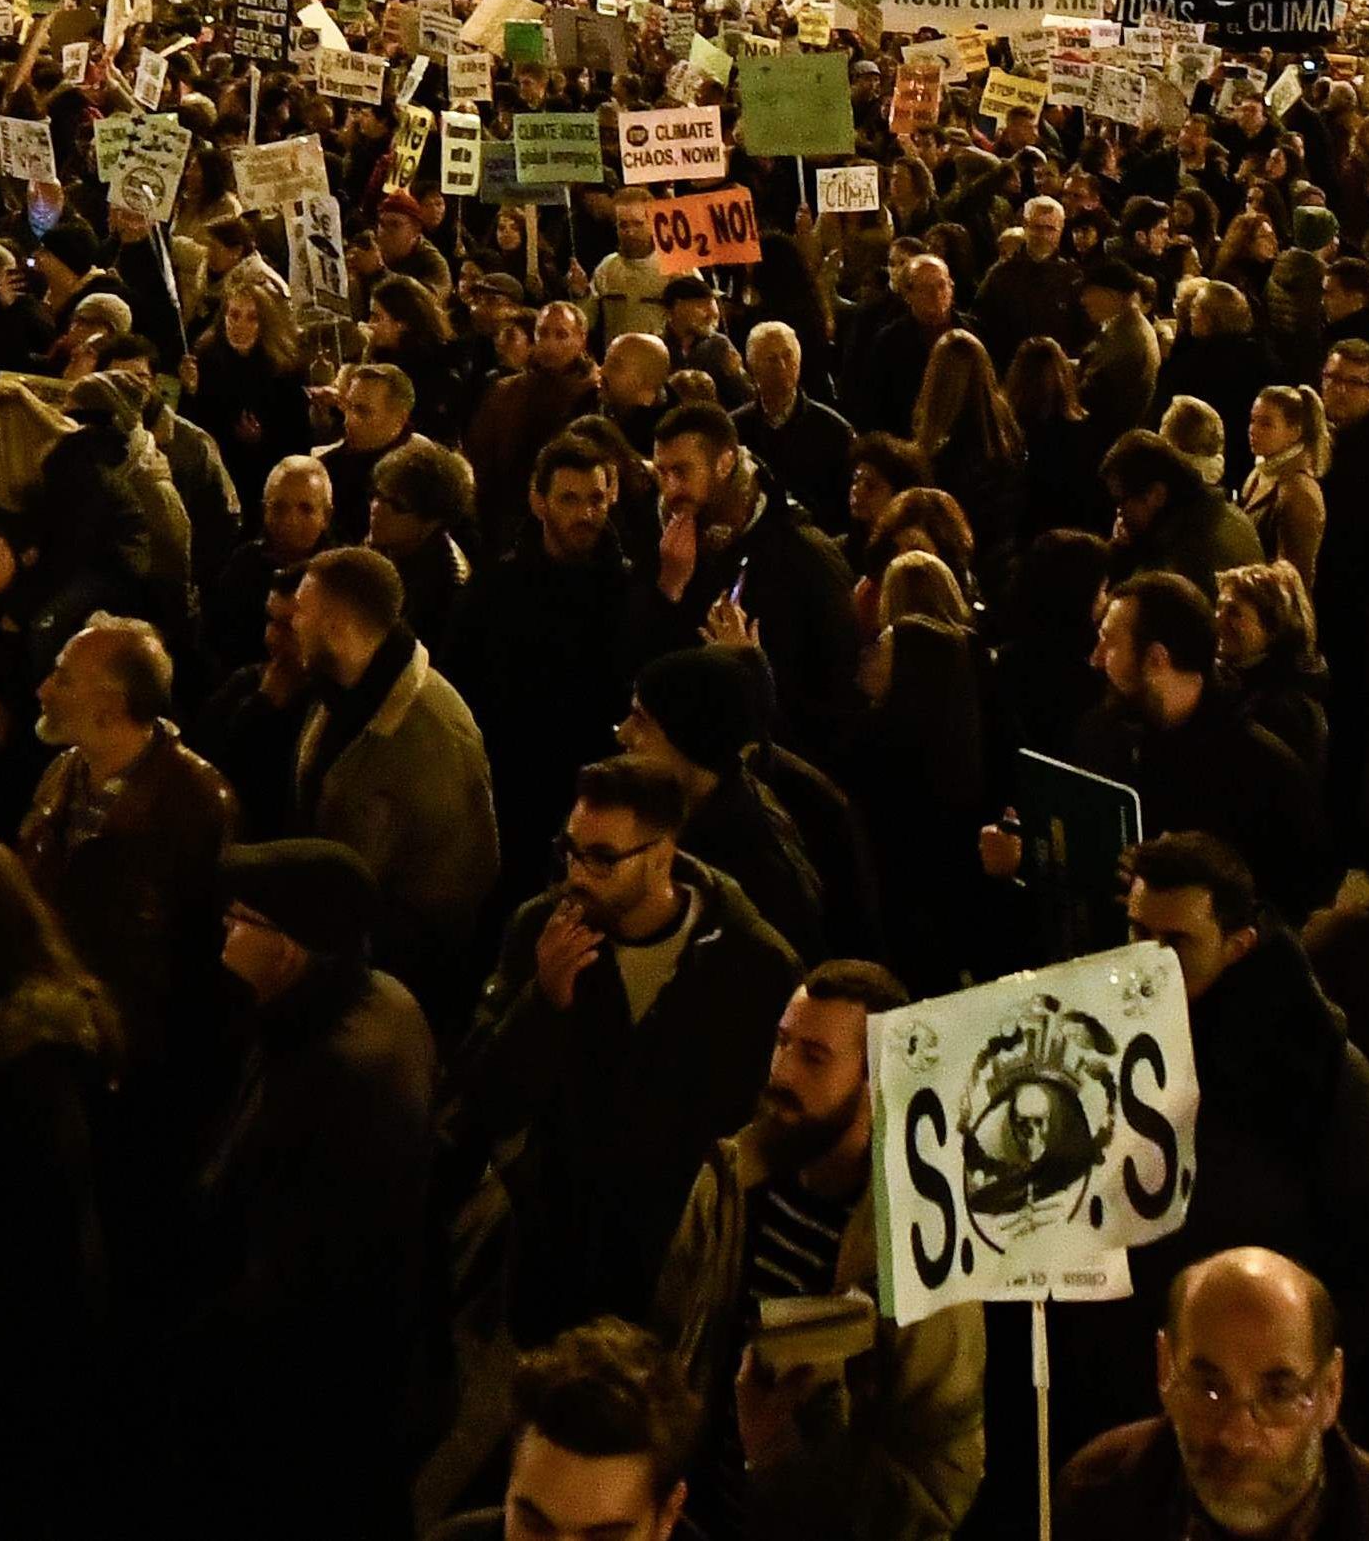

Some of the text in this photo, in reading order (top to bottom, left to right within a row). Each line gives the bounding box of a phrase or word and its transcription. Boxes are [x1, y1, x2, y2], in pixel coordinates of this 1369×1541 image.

[655, 122, 715, 141] CLIMATE
[623, 146, 721, 169] CHAOS, NOW!
[709, 199, 758, 245] NO!
